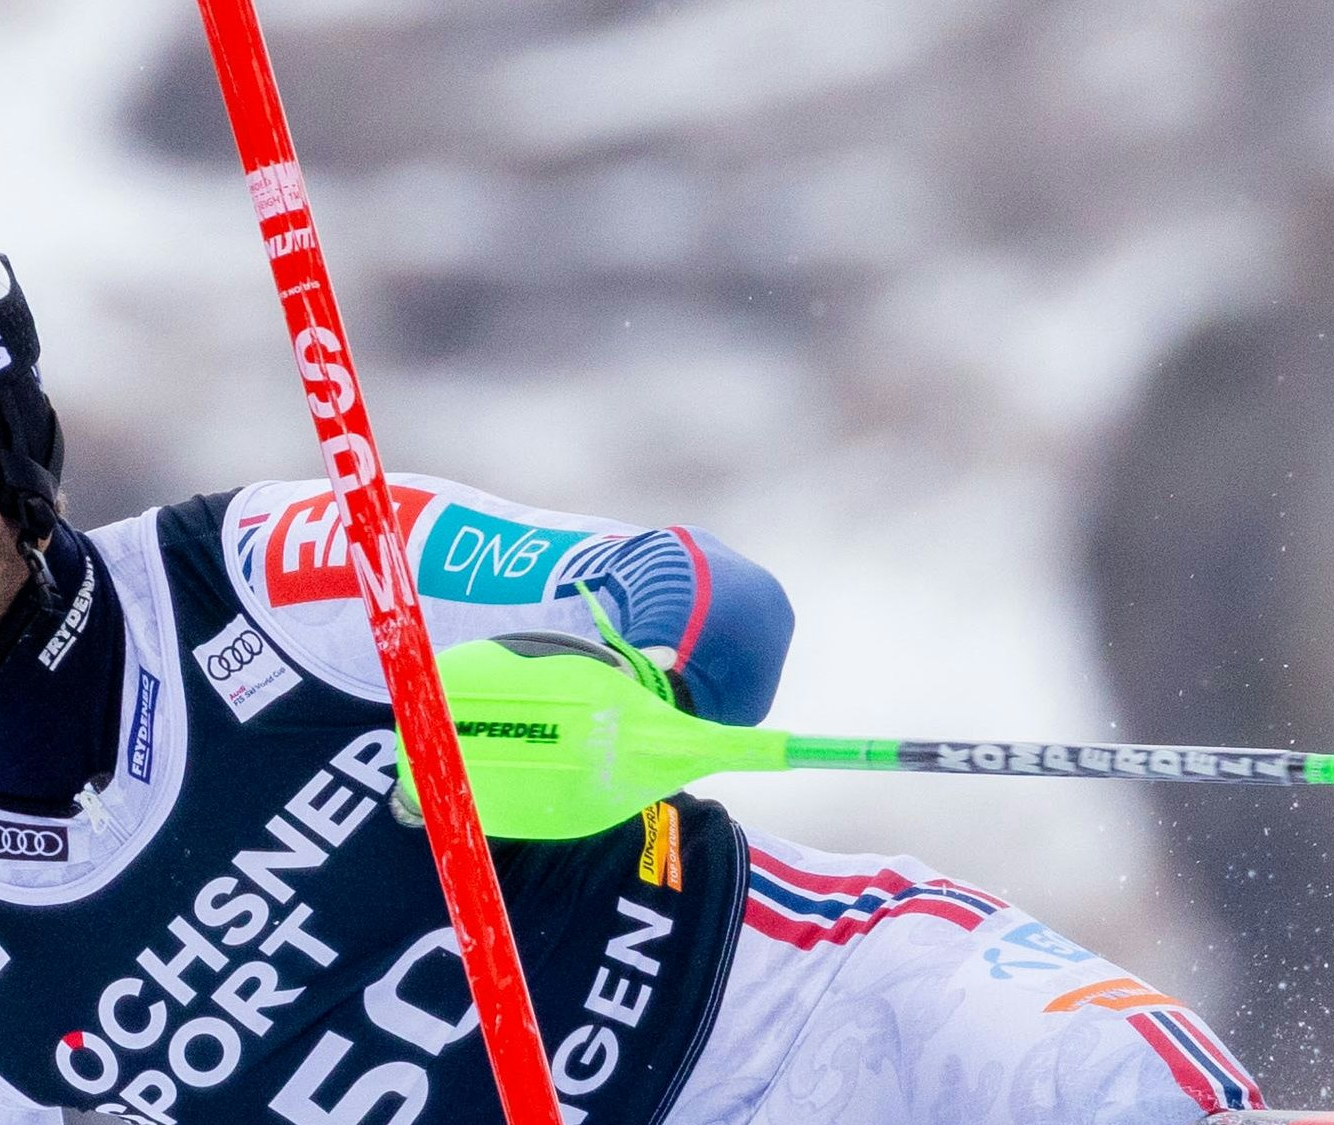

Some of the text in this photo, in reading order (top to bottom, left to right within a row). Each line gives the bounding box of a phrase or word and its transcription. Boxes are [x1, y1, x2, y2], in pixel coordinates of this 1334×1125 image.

[443, 525, 551, 596] DNB
[457, 721, 559, 744] MPERDELL
[55, 730, 399, 1095] OCHSNER
